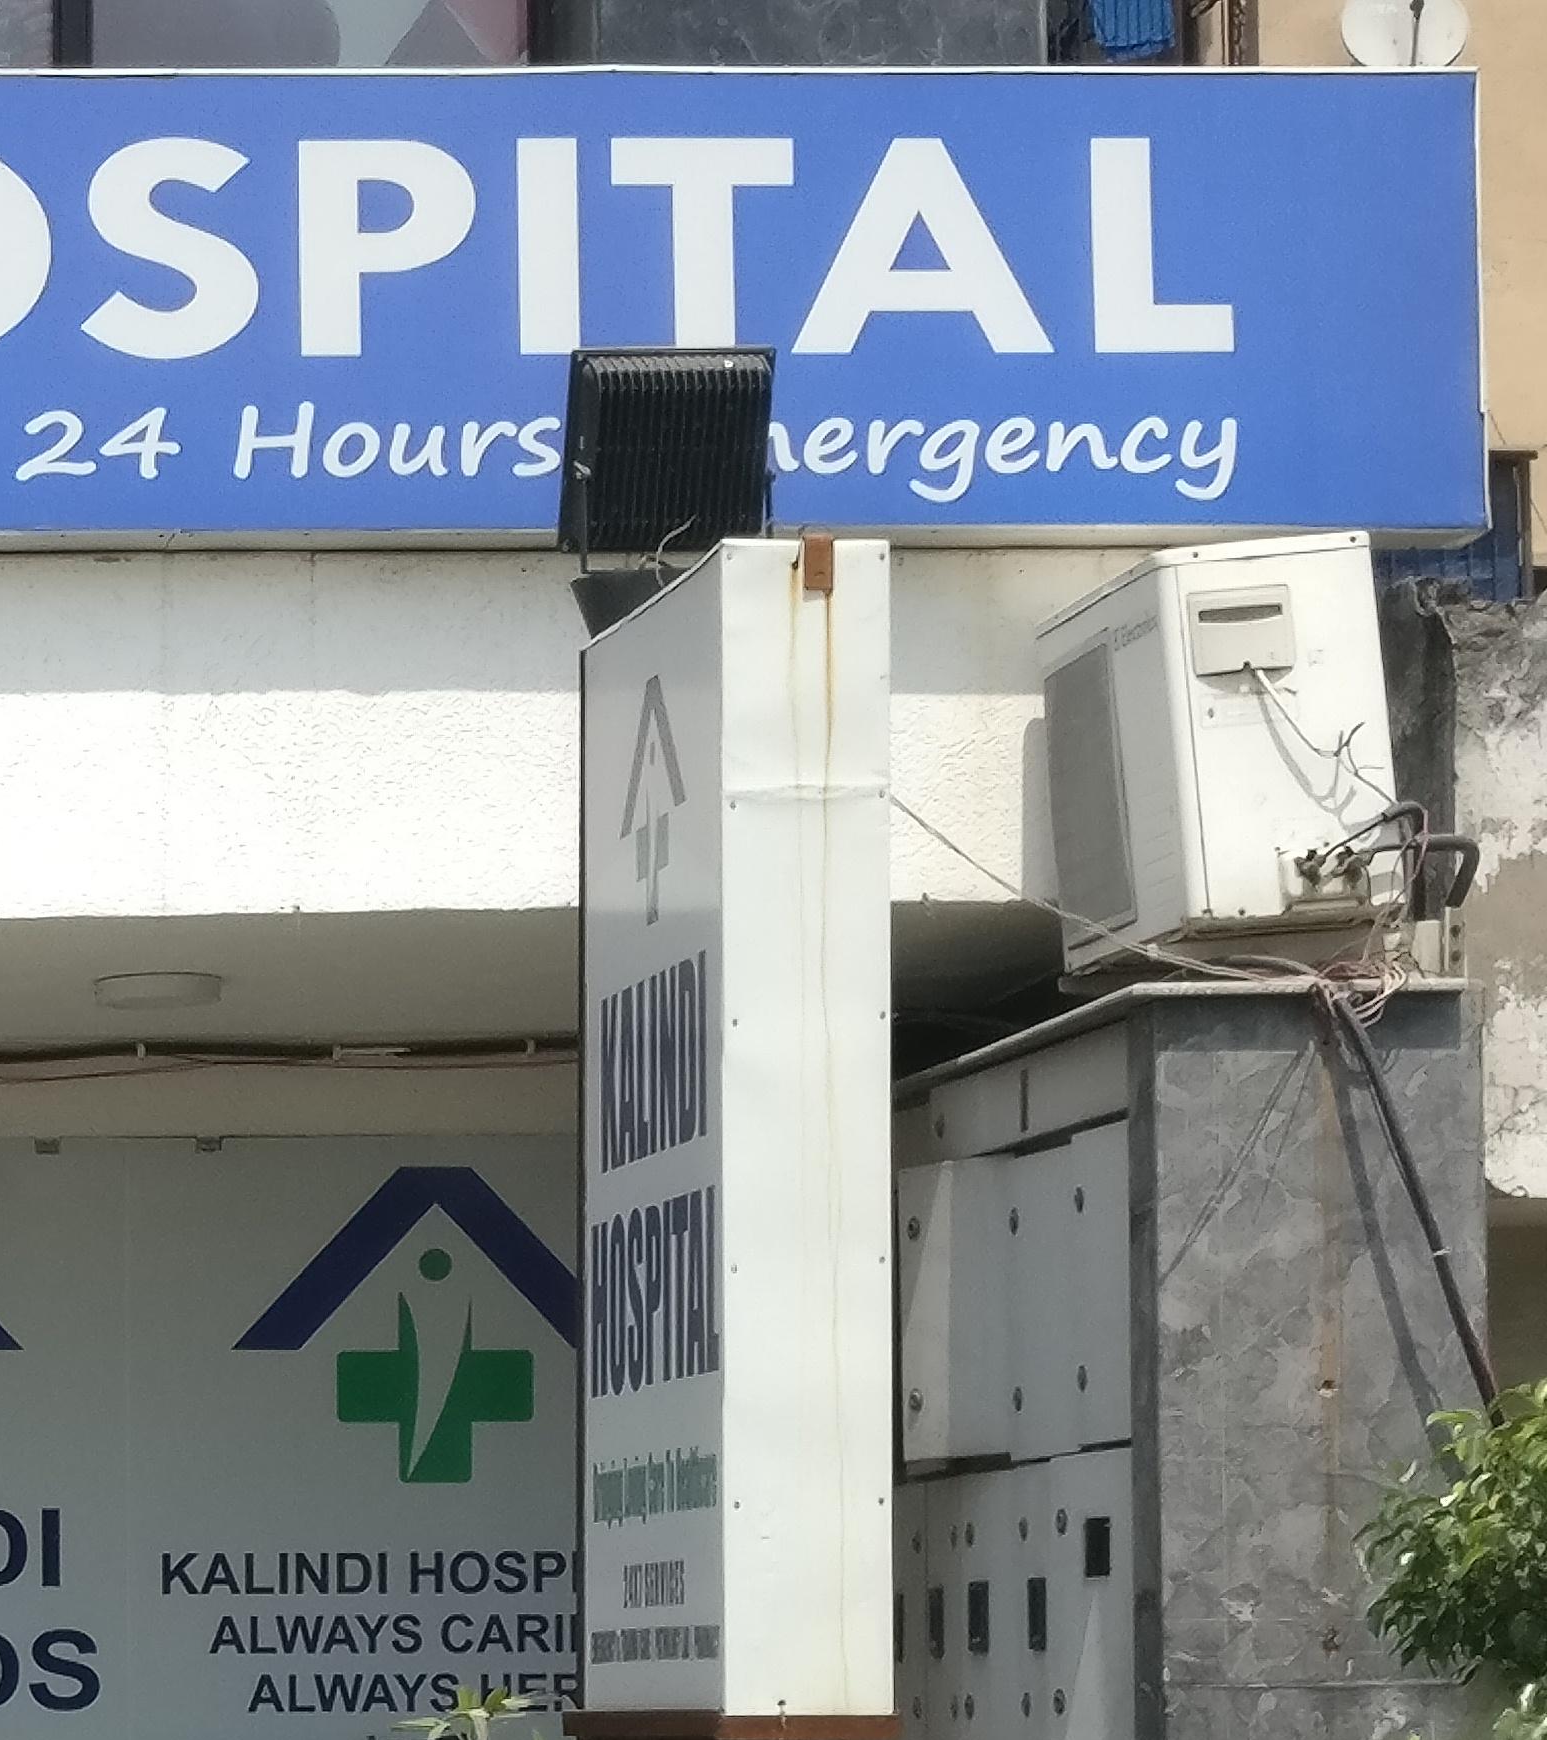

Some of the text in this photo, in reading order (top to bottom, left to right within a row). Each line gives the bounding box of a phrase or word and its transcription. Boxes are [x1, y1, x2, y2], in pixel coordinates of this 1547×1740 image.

[15, 407, 182, 482] 24
[232, 400, 563, 480] Hours
[600, 950, 707, 1175] KALINDI
[591, 1185, 719, 1399] HOSPITAL
[160, 1551, 389, 1595] KALINDI
[209, 1613, 423, 1655] ALWAYS
[440, 1613, 579, 1653] CARI
[247, 1673, 460, 1713] ALWAYS
